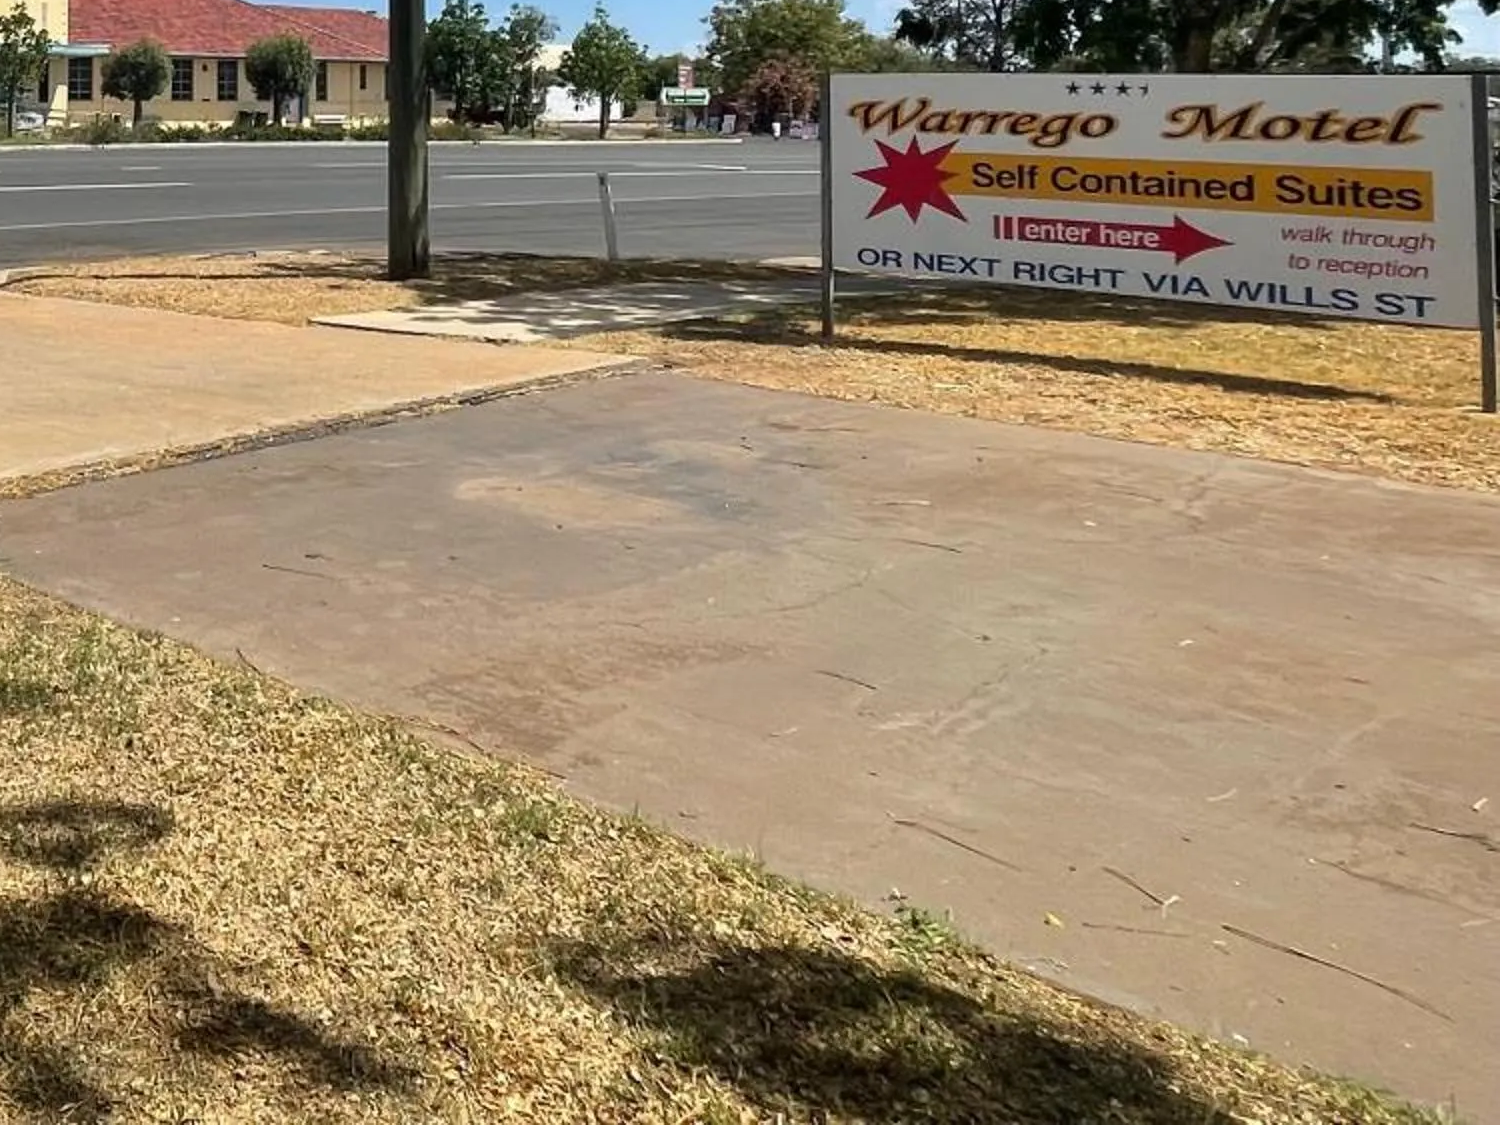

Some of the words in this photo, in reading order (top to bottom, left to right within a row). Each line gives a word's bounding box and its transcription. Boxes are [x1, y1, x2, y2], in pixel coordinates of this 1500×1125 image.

[847, 96, 1118, 148] Warrego
[1161, 100, 1443, 145] Motel
[971, 162, 1038, 190] Self
[1051, 166, 1255, 202] Contained
[1275, 174, 1423, 211] Suites
[1024, 221, 1092, 244] enter
[1099, 224, 1160, 248] here
[1280, 225, 1333, 244] walk
[1342, 228, 1436, 254] through
[857, 248, 902, 268] OR
[913, 252, 1001, 278] NEXT
[1012, 260, 1125, 289] RIGHT
[1142, 272, 1210, 299] VIA
[1224, 278, 1360, 311] WILLS
[1374, 292, 1437, 318] ST
[1288, 253, 1311, 270] to
[1317, 257, 1430, 279] reception
